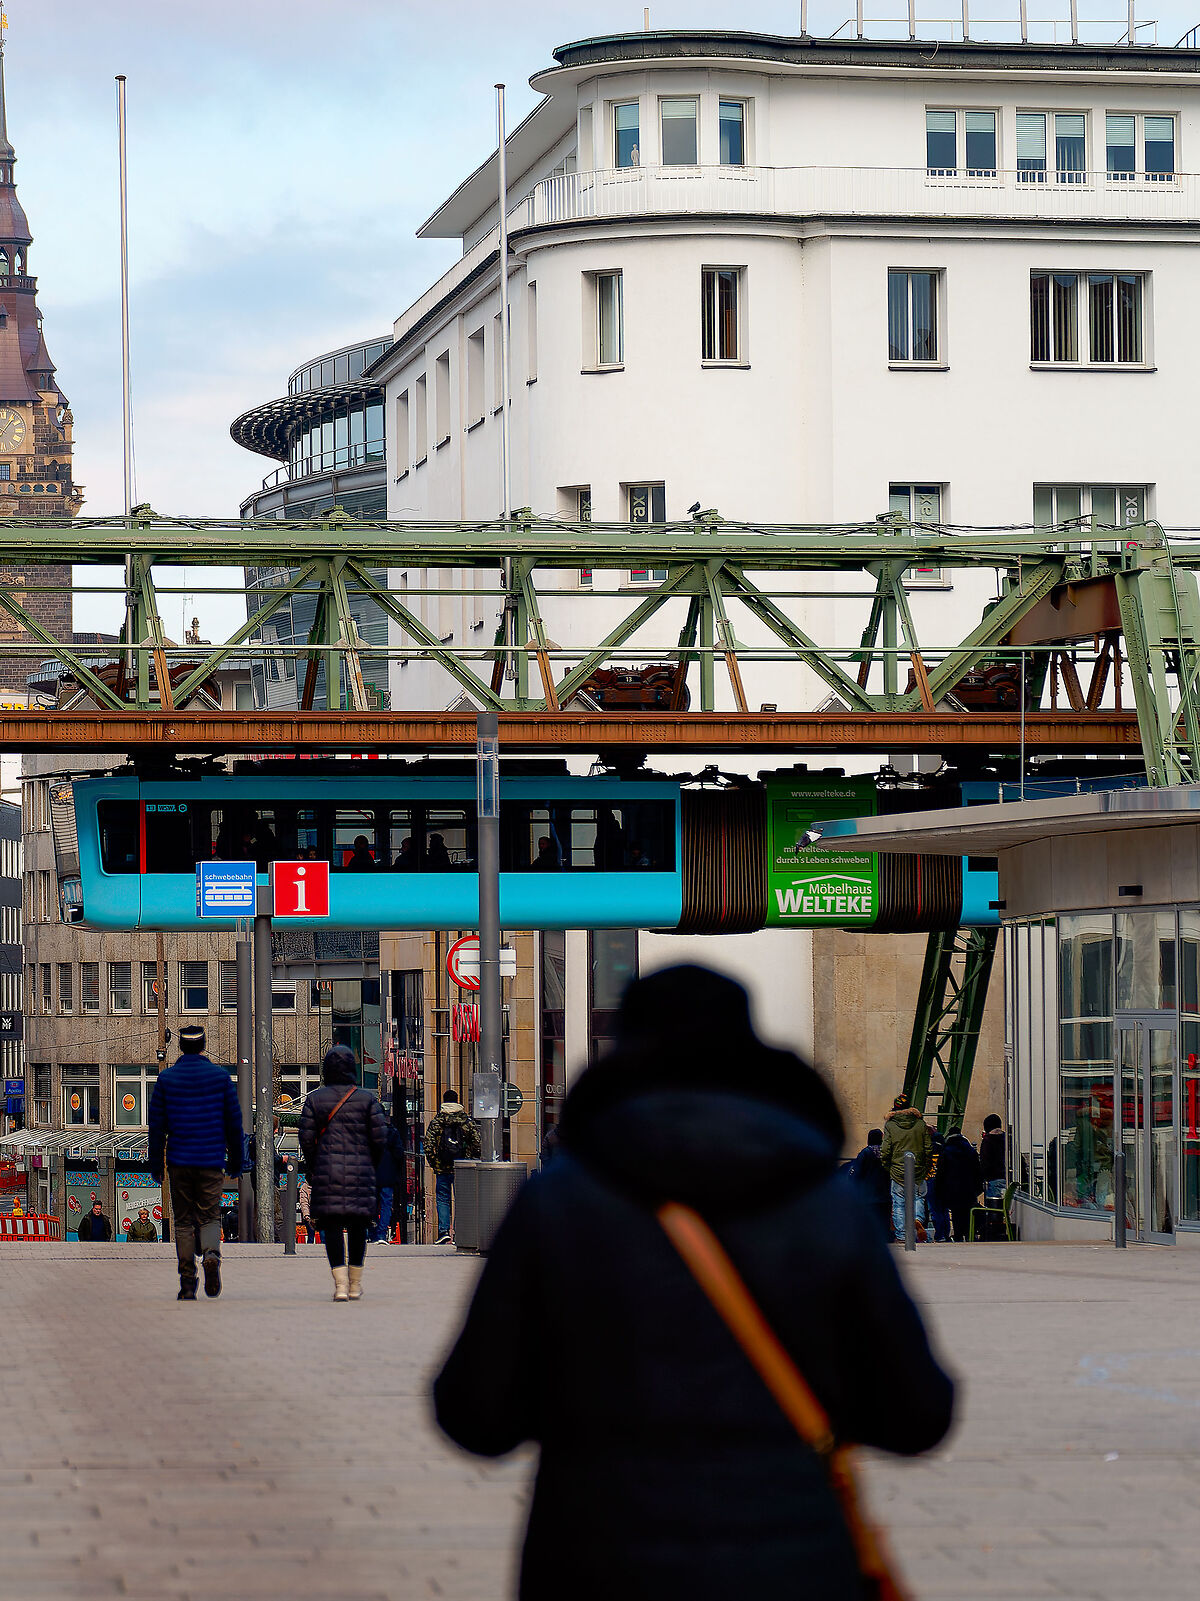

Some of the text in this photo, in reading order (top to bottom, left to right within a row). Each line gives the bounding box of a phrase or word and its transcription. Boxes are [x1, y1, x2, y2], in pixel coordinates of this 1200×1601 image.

[791, 789, 857, 798] www.welteke.de
[805, 856, 830, 864] Leben
[830, 856, 870, 864] schweben
[204, 873, 253, 881] schwebebahn
[808, 883, 873, 895] Möbelhaus
[774, 888, 872, 913] WELTEKE
